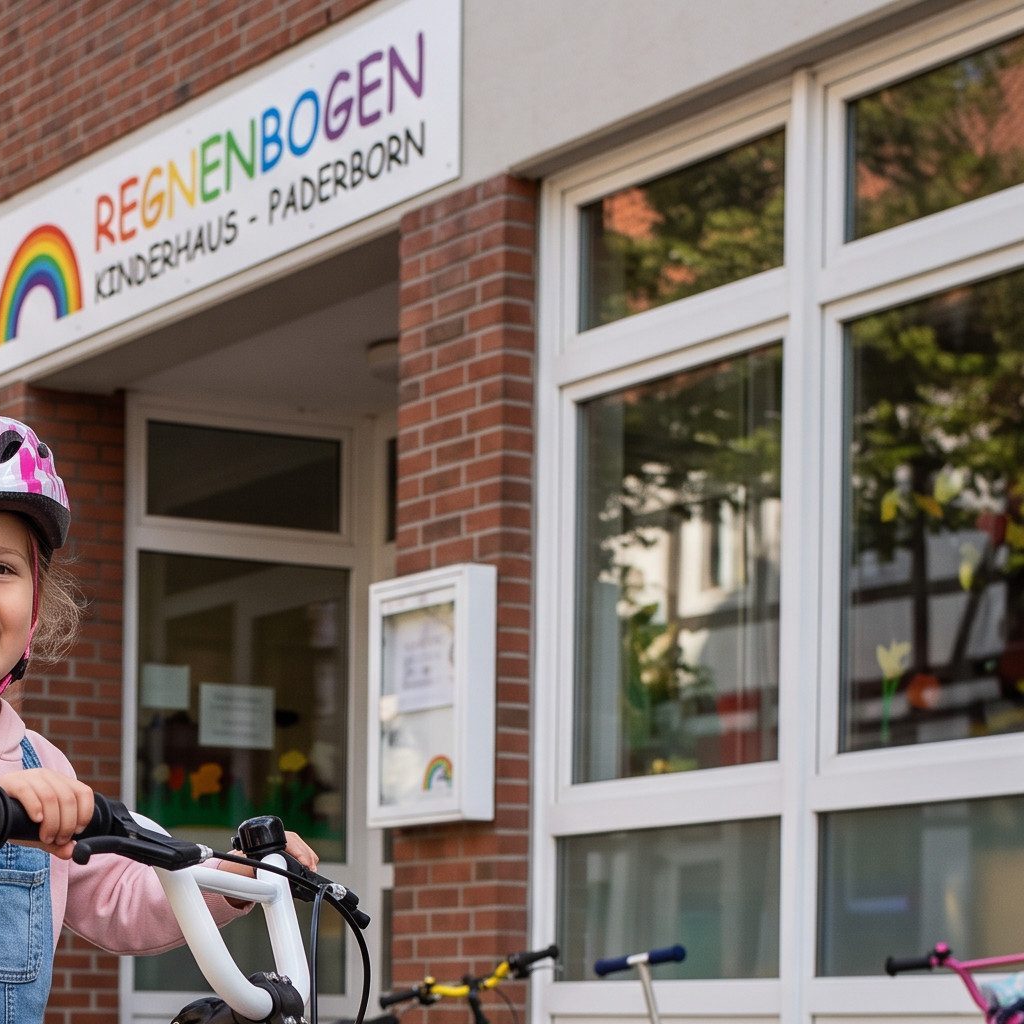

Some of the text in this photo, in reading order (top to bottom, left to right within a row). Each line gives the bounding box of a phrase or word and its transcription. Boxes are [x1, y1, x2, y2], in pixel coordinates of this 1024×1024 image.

[94, 31, 424, 253] REGNENBOGEN
[94, 210, 239, 302] KINDERHAUS
[268, 121, 425, 225] PADERBORN
